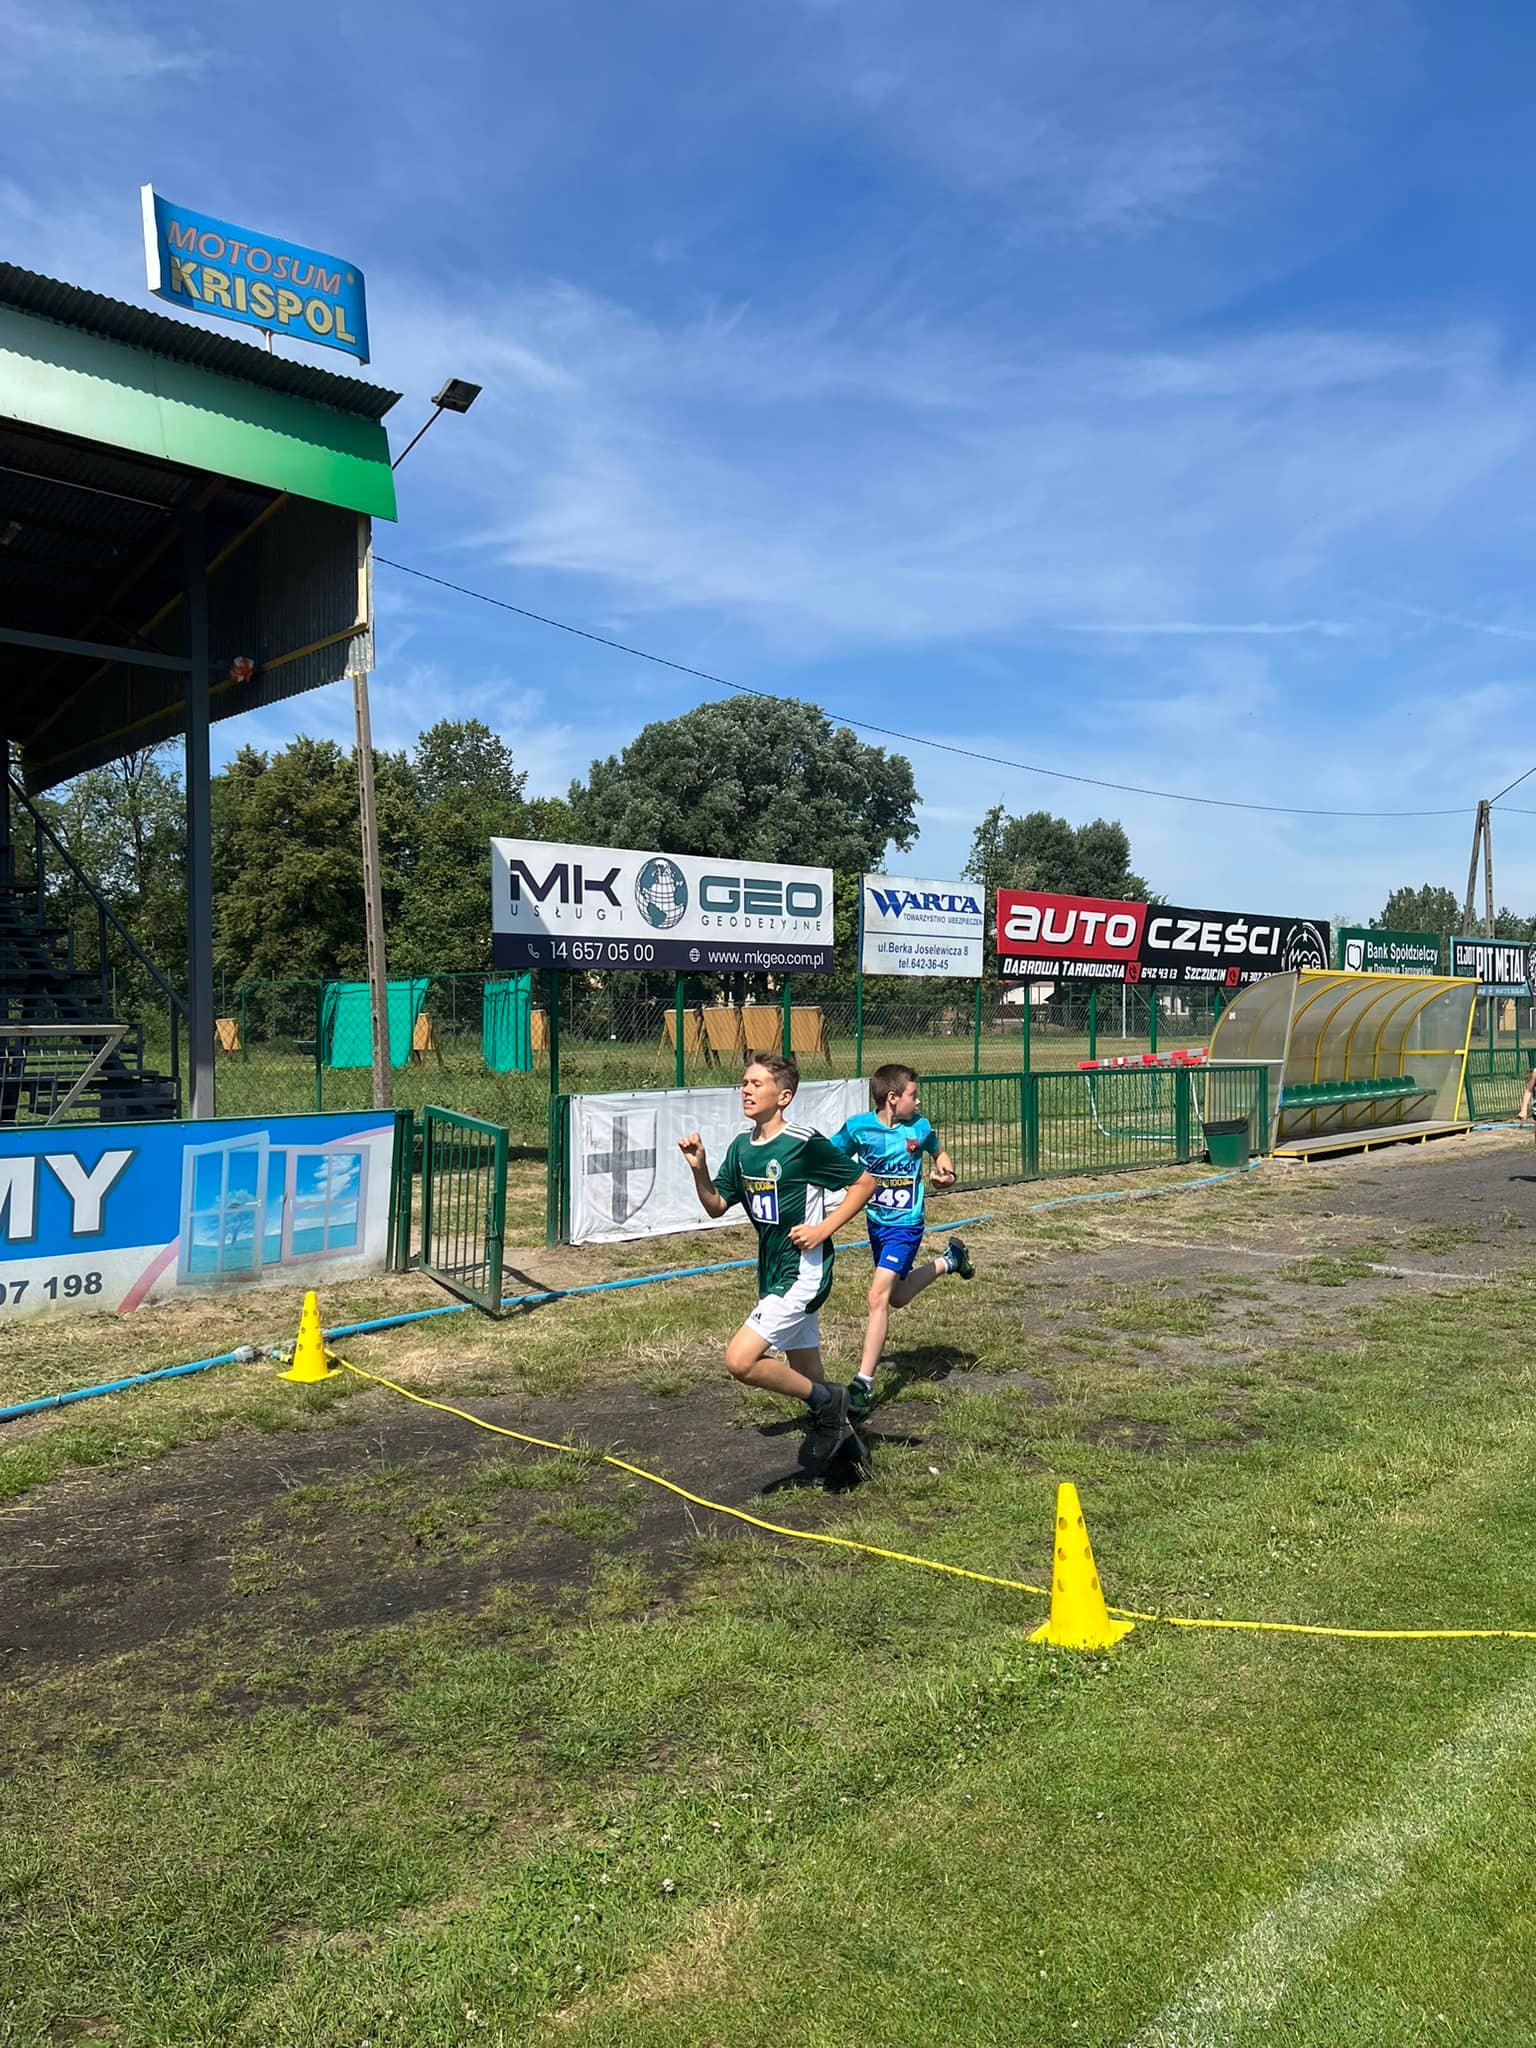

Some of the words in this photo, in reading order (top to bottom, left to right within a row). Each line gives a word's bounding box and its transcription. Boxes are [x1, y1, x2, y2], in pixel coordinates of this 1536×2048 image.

[167, 221, 342, 296] MOTOSUM
[170, 255, 356, 344] KRISPOL
[510, 859, 622, 907] MK
[699, 875, 823, 917] GEO
[510, 903, 623, 921] USŁUGI
[866, 887, 982, 919] WARTA
[701, 915, 822, 932] GEODEZYJNE
[903, 913, 945, 923] TOWARZYSTWO
[915, 944, 962, 956] Joselewicza
[963, 945, 968, 956] 8
[1147, 918, 1280, 957] CZĘŚCI
[551, 941, 568, 959] 14
[572, 941, 603, 960] 657
[607, 942, 629, 961] 05
[633, 943, 654, 962] 00
[708, 951, 824, 966] www.mkgeo.com.pl
[1367, 942, 1388, 959] Bank
[1390, 943, 1438, 965] Spółdzielczy
[1476, 947, 1493, 982] PIT
[1495, 948, 1526, 982] METAL
[1003, 958, 1059, 976] DĄBROWA
[1062, 961, 1125, 978] TARNOWSKA
[1141, 967, 1157, 978] 642
[1158, 968, 1168, 978] 43
[1185, 966, 1227, 981] SZCZUCIN
[43, 1271, 102, 1300] 198
